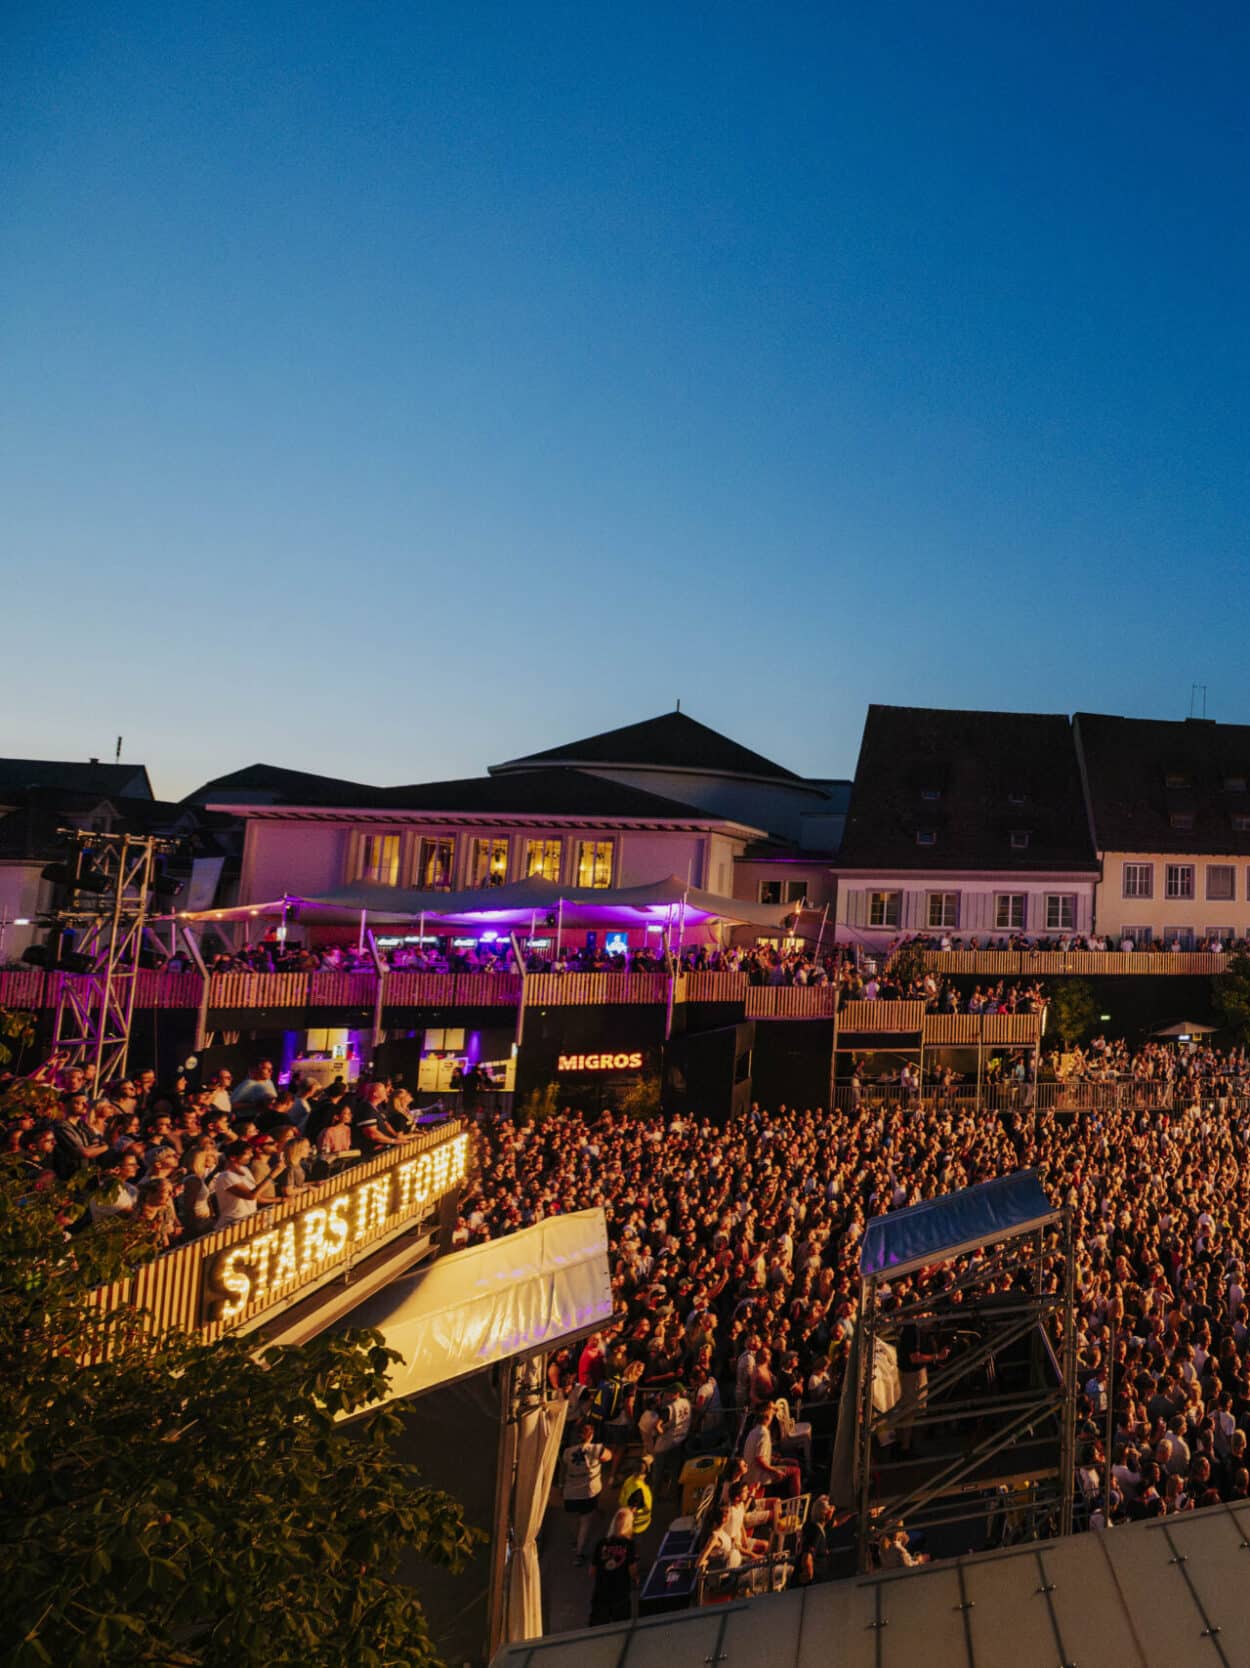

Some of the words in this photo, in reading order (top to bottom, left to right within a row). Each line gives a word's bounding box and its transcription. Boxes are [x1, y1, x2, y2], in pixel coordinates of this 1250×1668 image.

[558, 1053, 642, 1070] MIGROS
[222, 1195, 349, 1319] STARS
[355, 1173, 392, 1241] IN
[399, 1133, 469, 1209] TOWN
